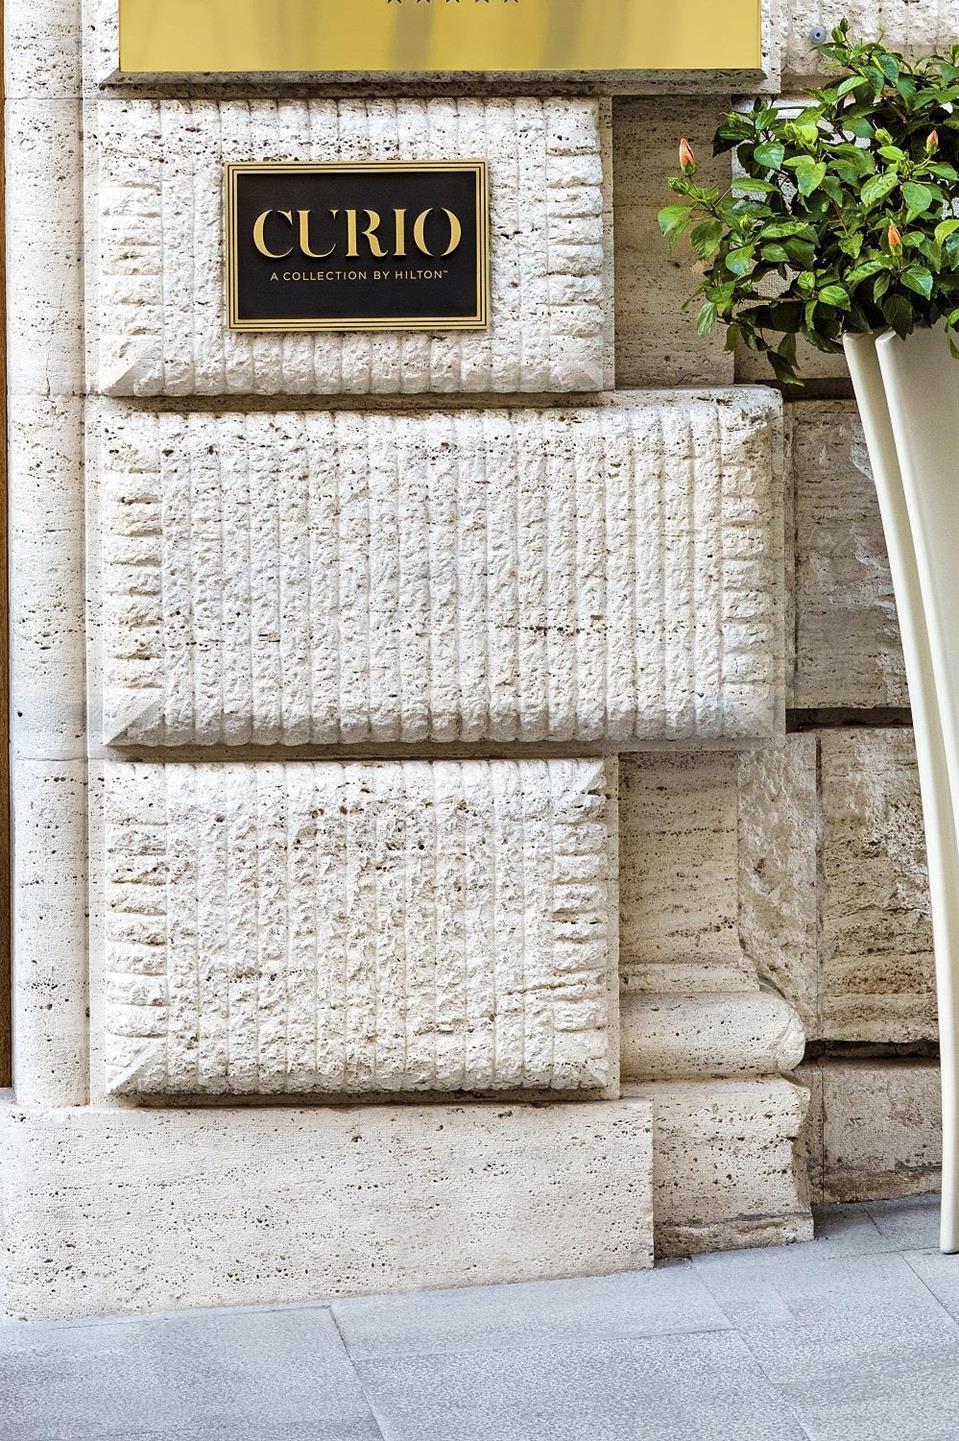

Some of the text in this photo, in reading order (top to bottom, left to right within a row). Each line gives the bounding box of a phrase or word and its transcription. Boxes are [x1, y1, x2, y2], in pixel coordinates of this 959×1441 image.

[252, 207, 462, 259] CURIO
[270, 272, 279, 281] A
[282, 271, 367, 281] COLLECTION
[373, 270, 390, 280] BY
